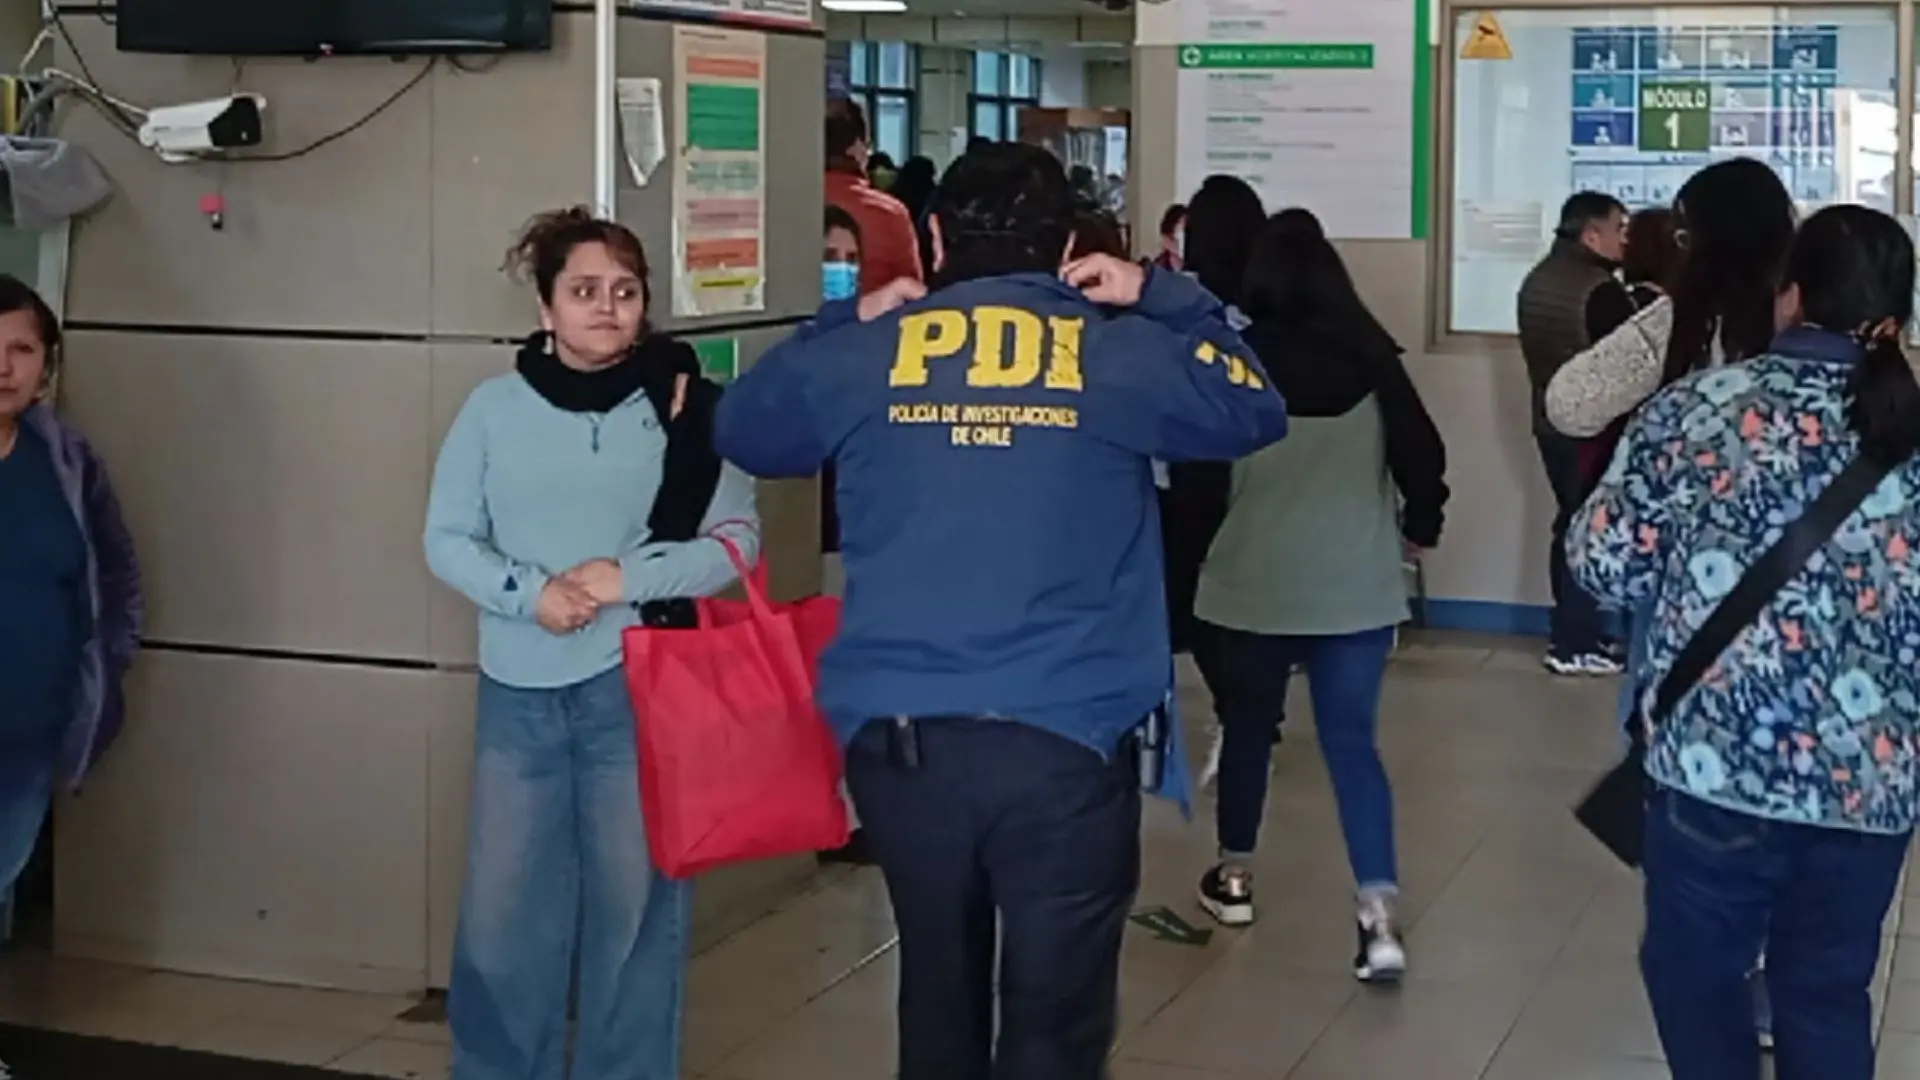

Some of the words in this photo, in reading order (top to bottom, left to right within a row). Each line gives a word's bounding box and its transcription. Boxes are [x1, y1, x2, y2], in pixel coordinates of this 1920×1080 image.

[1641, 86, 1708, 109] MÓDULO
[1663, 112, 1681, 149] 1
[888, 305, 1084, 391] PDI
[941, 404, 959, 423] DE
[961, 404, 1079, 428] INVESTIGACIONES
[951, 426, 971, 446] DE
[972, 427, 1012, 447] CHILE
